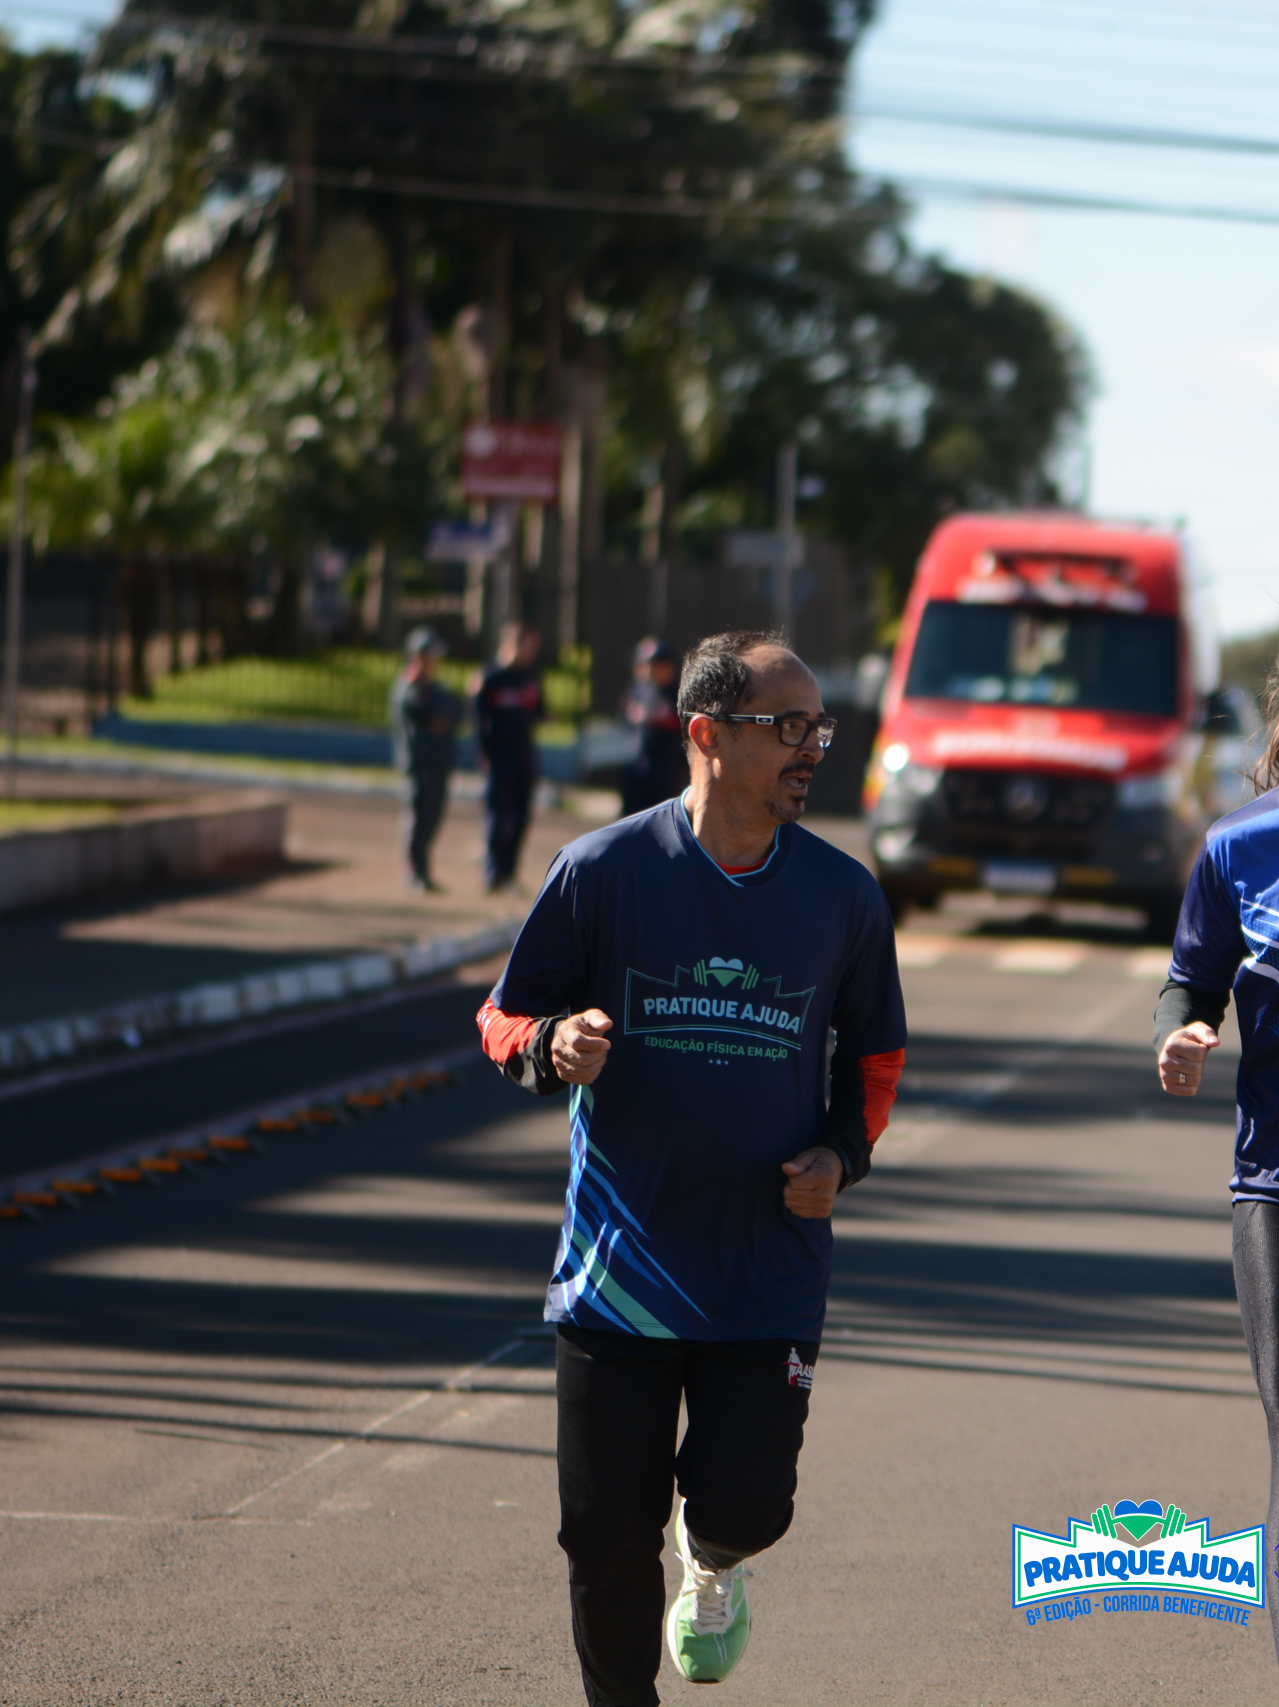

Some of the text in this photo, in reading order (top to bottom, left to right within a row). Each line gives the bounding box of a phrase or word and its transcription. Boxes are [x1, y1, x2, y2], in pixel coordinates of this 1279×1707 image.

[643, 997, 801, 1034] PRATIQUE AJUDA
[644, 1036, 788, 1062] EDUCAÇÃO FÍSICA EM AÇÃO
